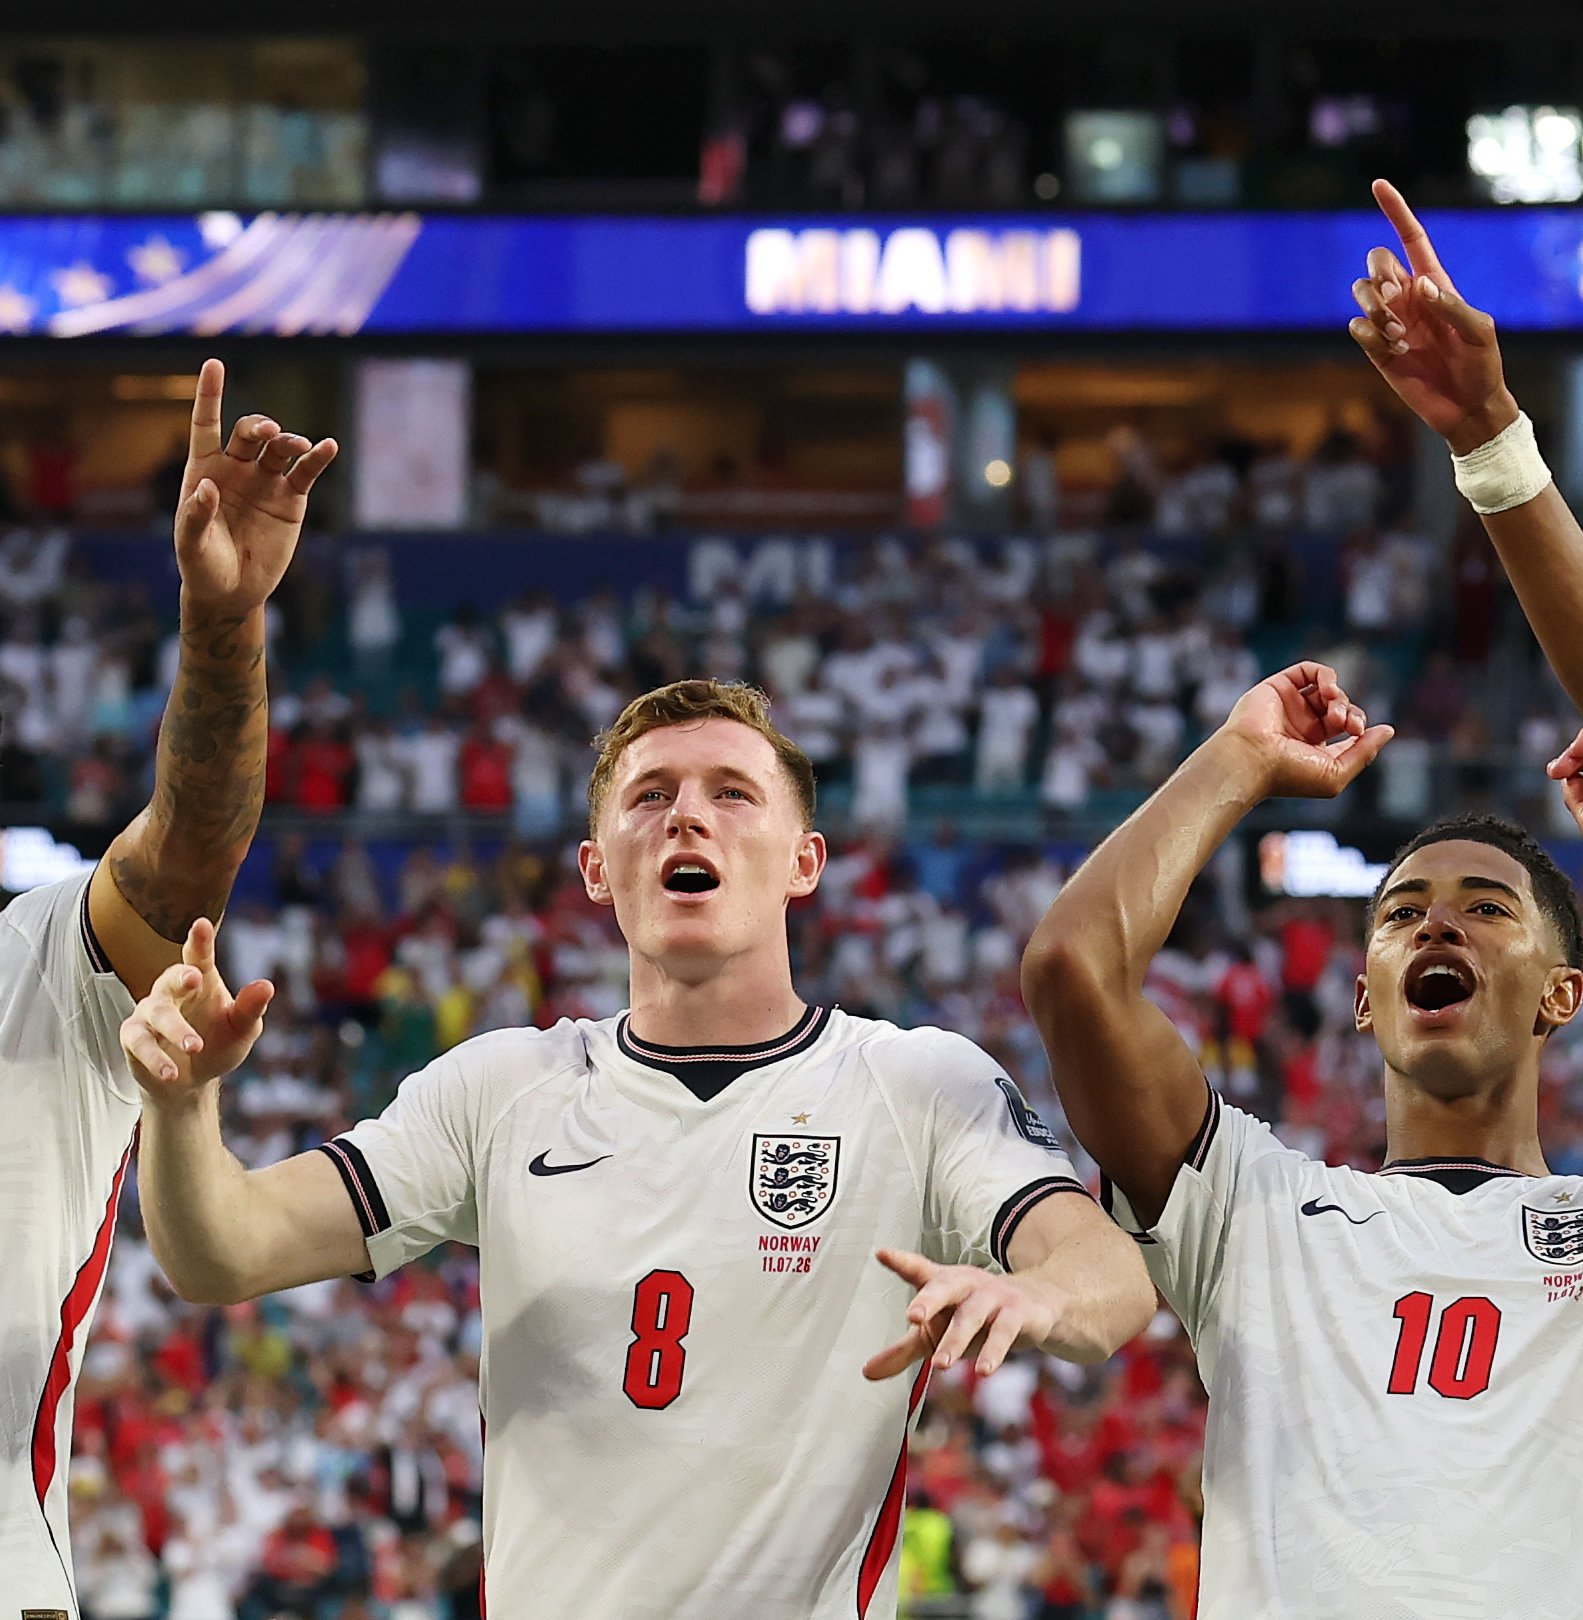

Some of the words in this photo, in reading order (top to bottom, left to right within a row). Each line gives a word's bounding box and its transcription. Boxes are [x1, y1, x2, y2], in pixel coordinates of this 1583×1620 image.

[745, 228, 1080, 313] MIAMI
[758, 1235, 821, 1252] NORWAY
[762, 1256, 812, 1273] 11.07.26
[622, 1269, 695, 1411] 8
[1387, 1290, 1502, 1401] 10
